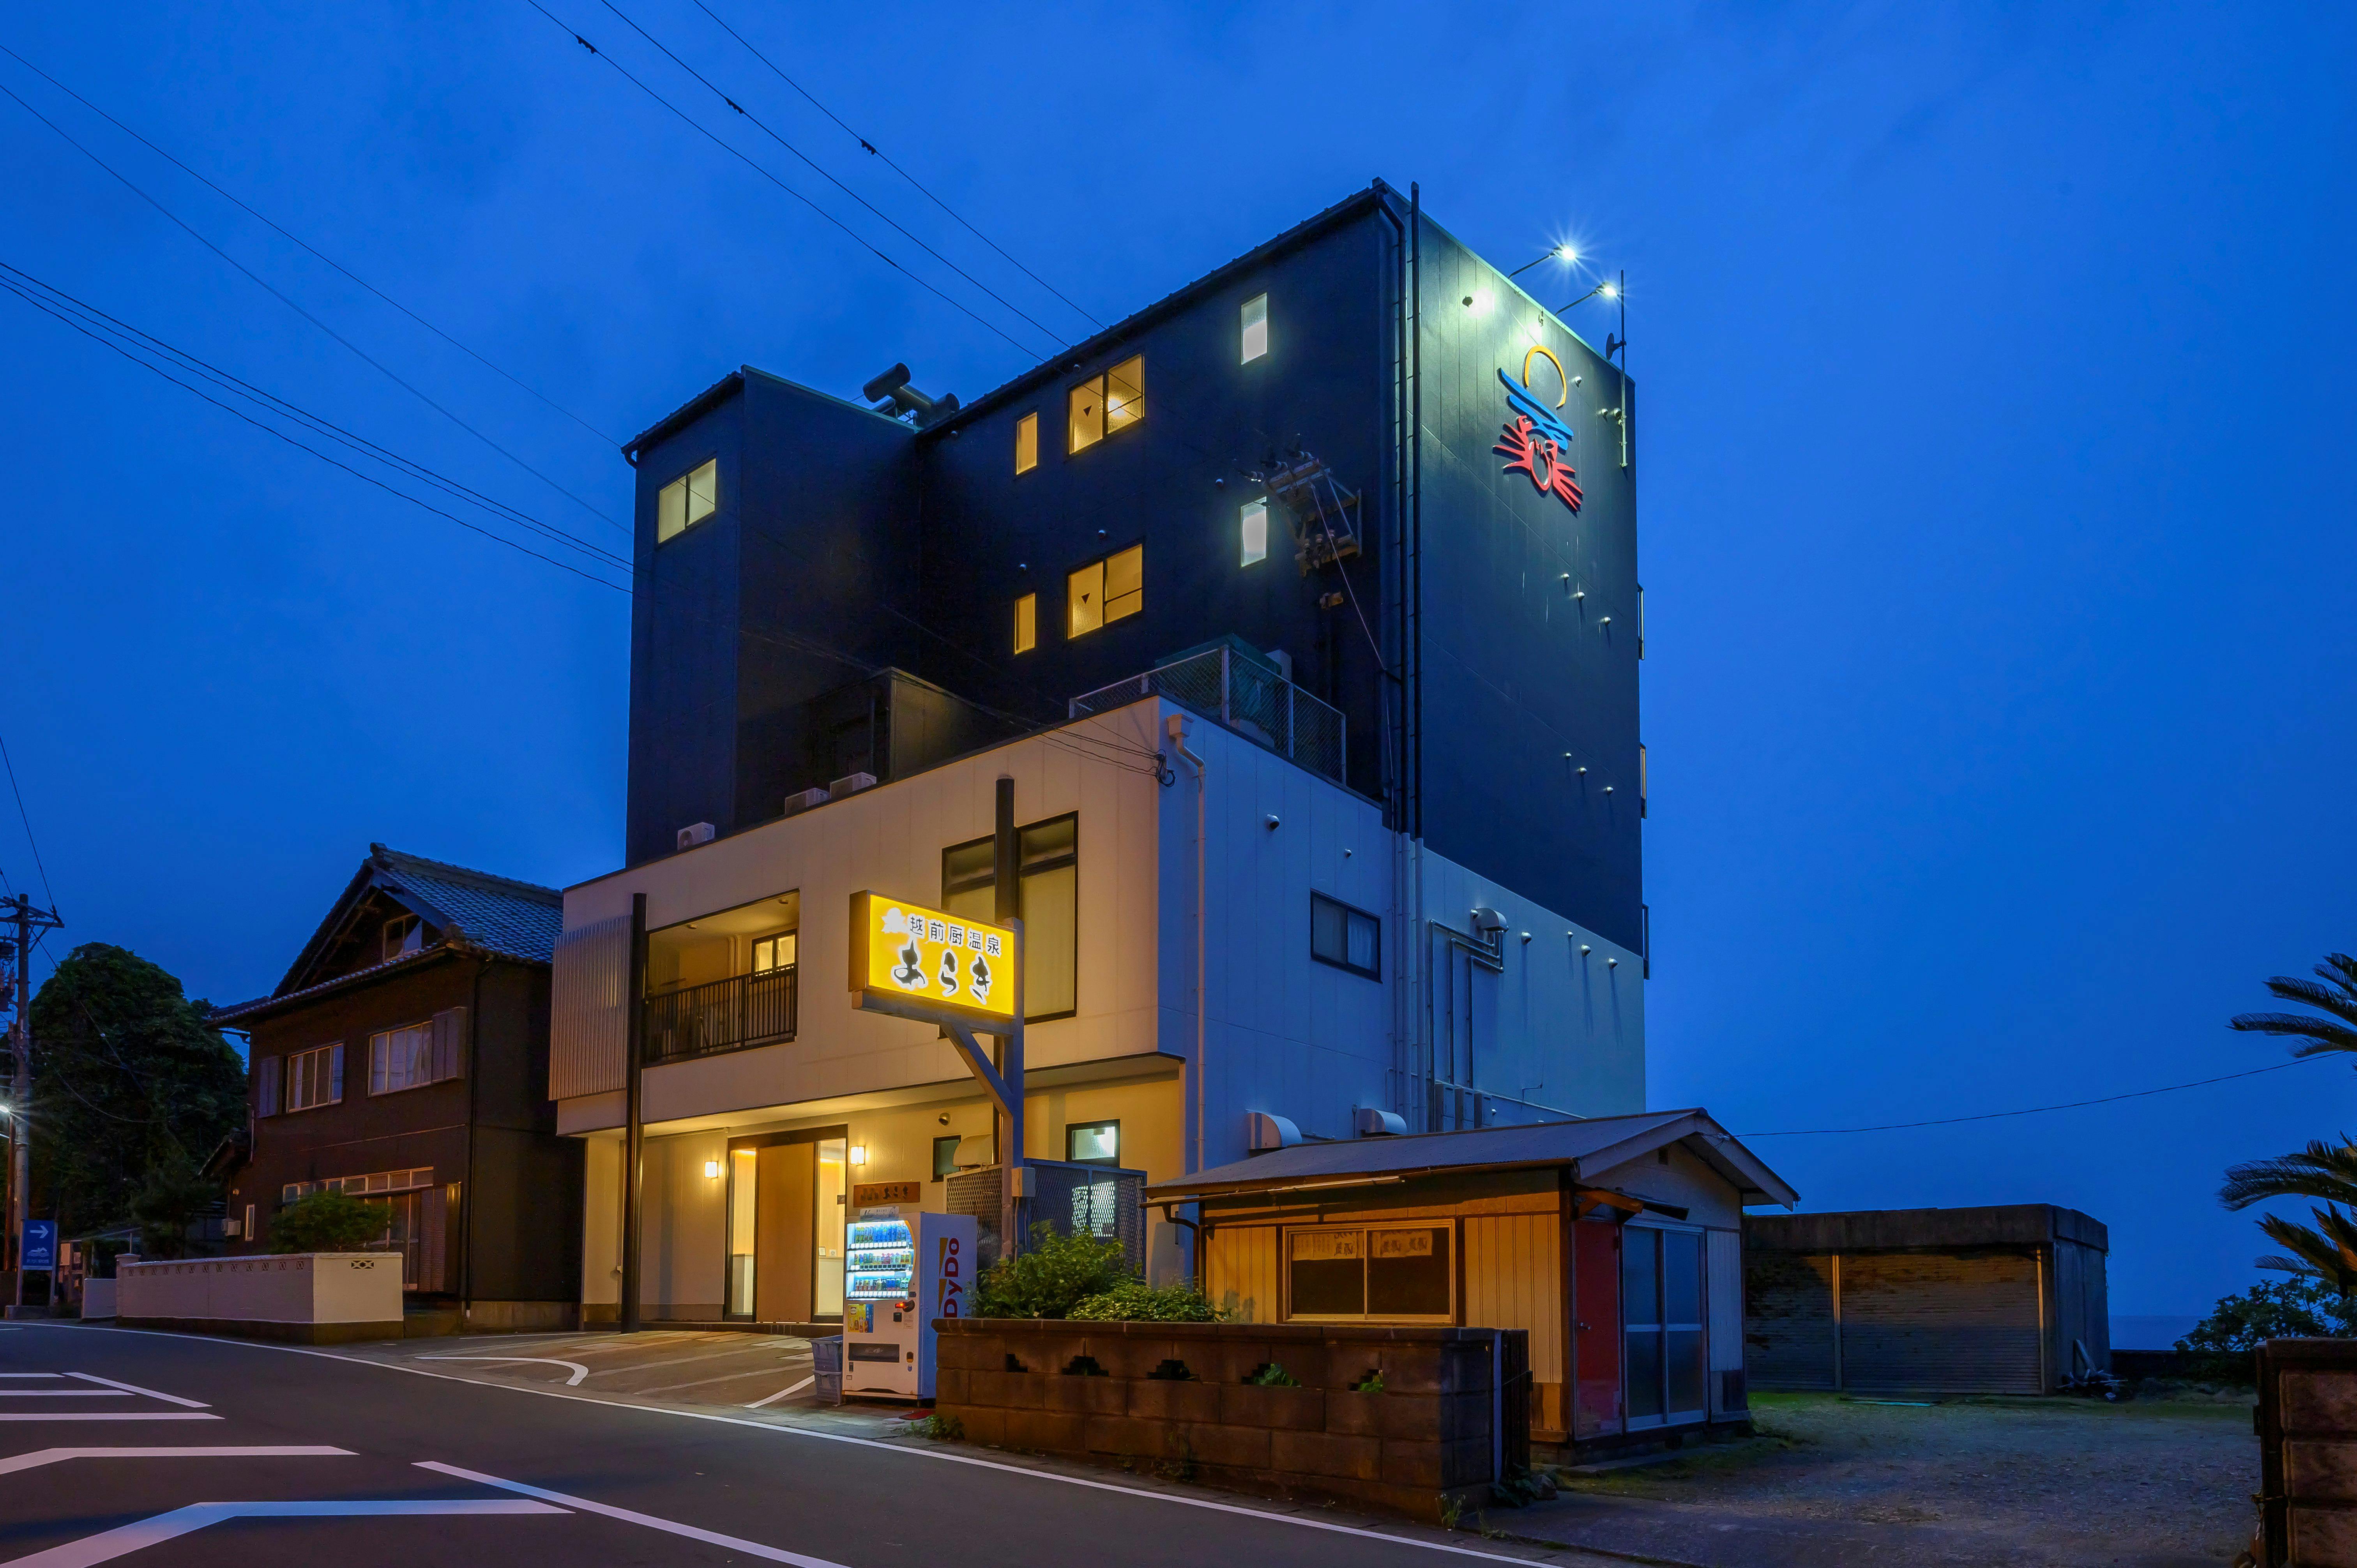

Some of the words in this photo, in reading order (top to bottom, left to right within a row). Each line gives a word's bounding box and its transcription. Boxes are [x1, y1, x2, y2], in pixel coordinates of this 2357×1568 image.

[909, 916, 1001, 956] 越前厨温泉
[894, 940, 990, 1000] よらき
